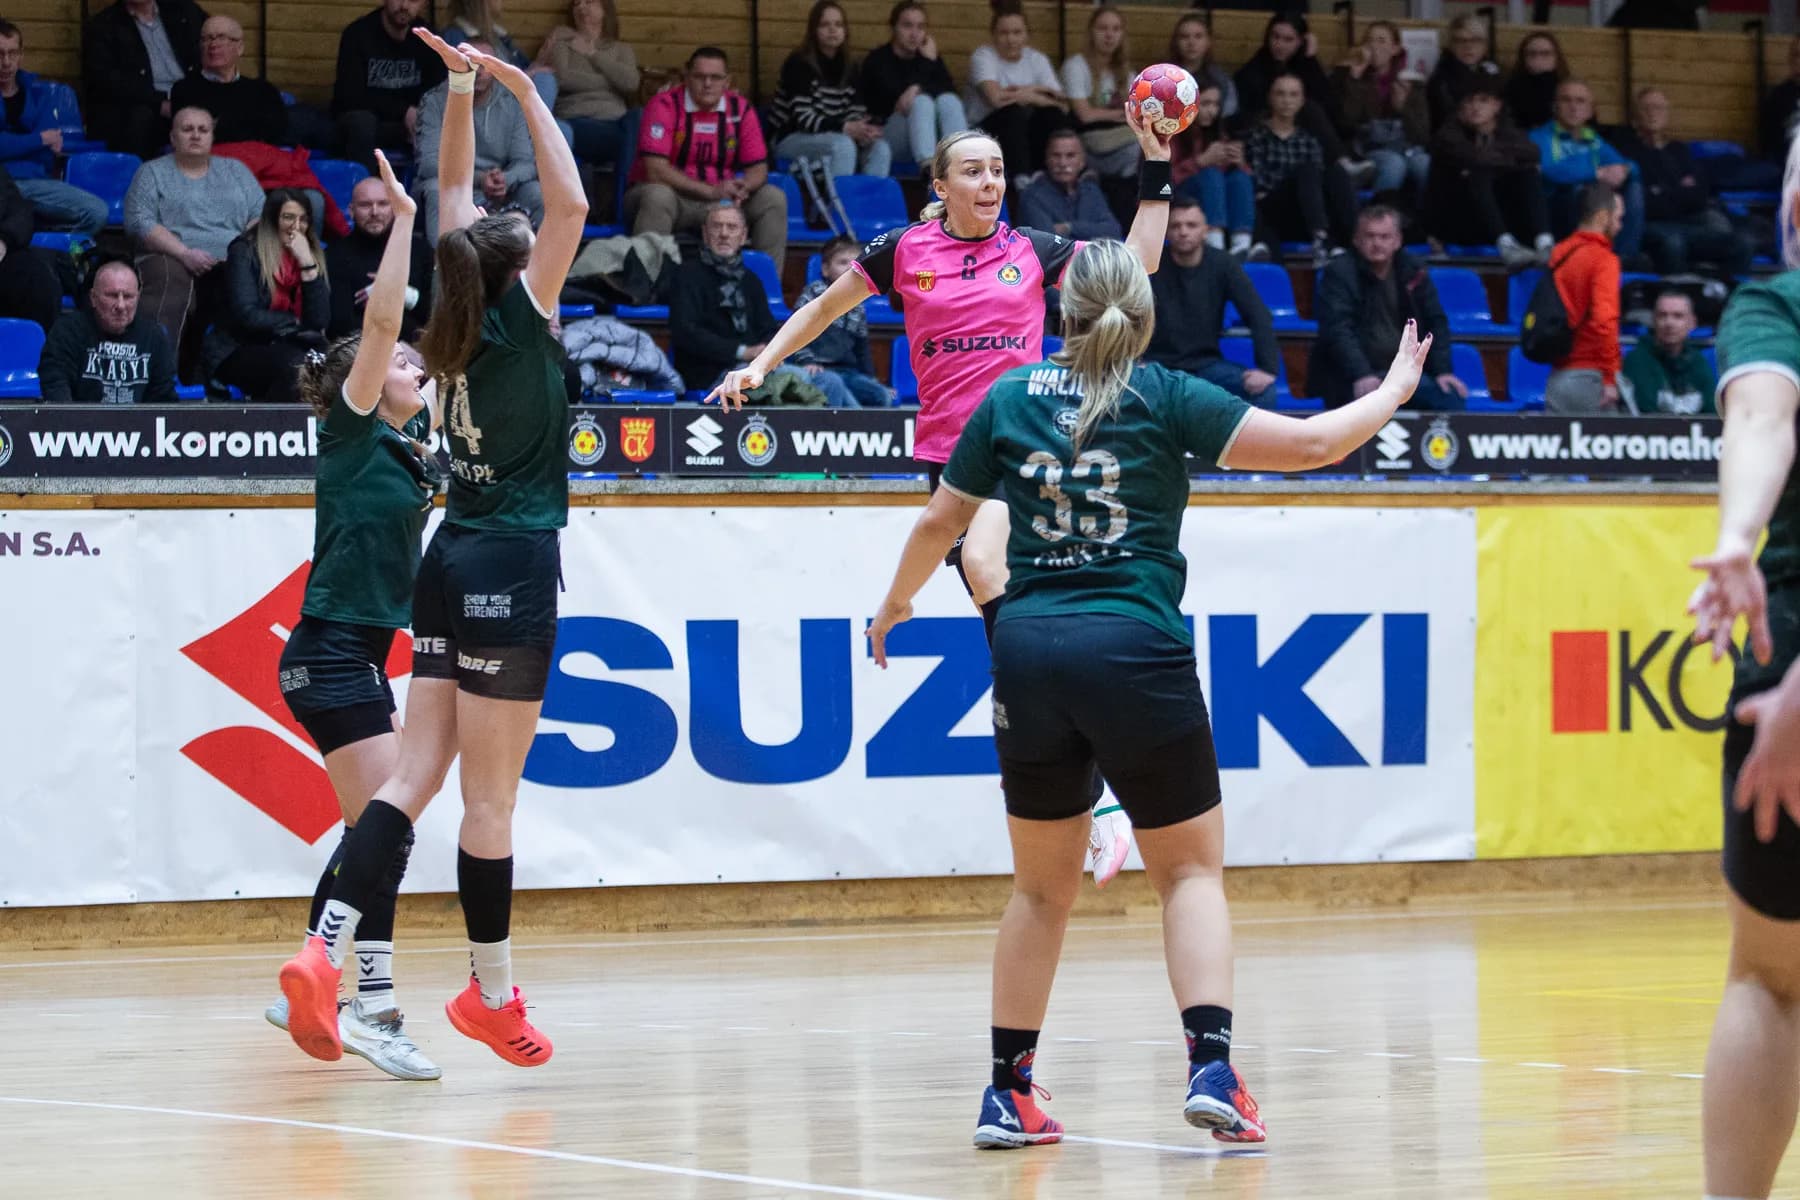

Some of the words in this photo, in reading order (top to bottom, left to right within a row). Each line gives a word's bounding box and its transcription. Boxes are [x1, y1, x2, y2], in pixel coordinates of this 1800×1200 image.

[942, 335, 1027, 353] SUZUKI
[624, 435, 649, 458] CK
[1019, 449, 1128, 544] 33
[32, 532, 101, 556] S.A.
[520, 612, 1430, 788] SUZKI
